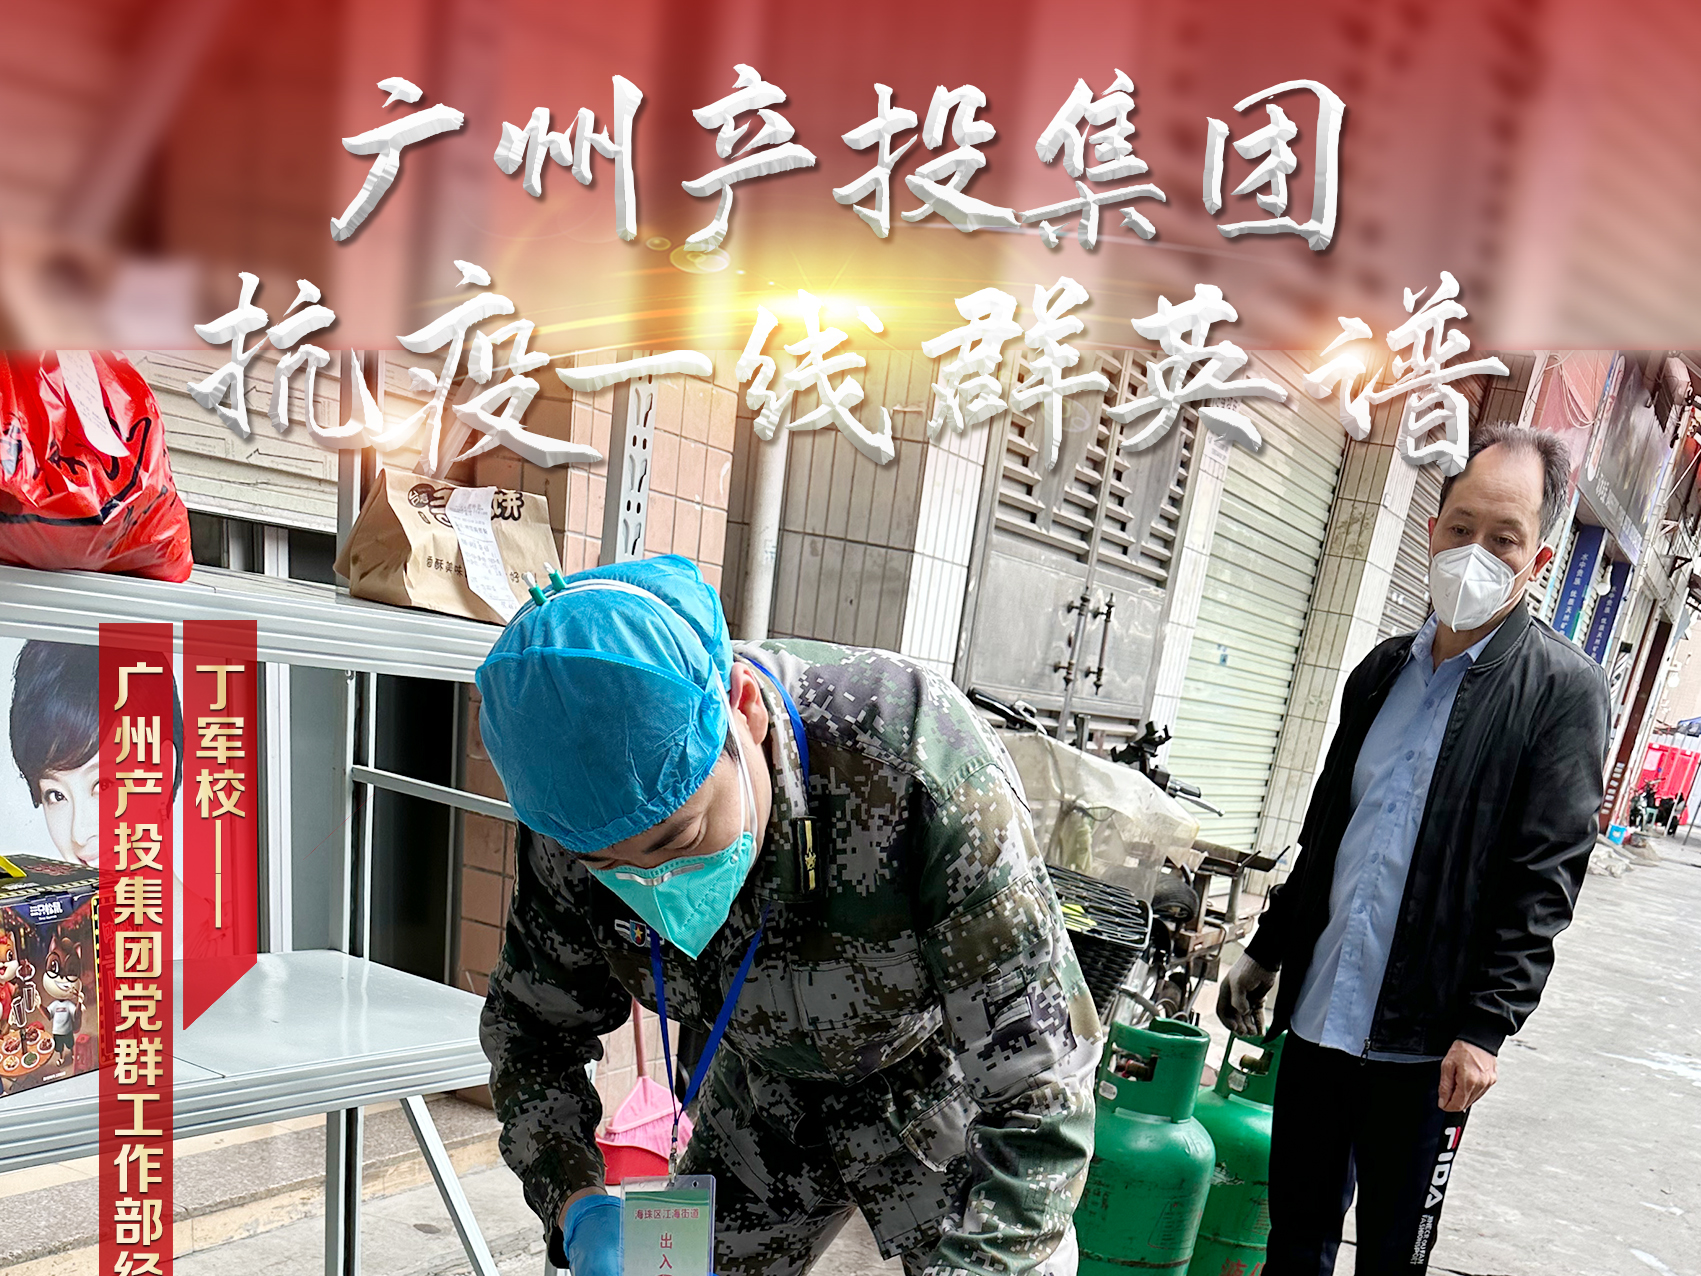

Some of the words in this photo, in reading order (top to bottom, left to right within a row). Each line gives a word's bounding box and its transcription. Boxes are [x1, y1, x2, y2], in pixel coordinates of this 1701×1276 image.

[1424, 1126, 1462, 1209] FIDA
[635, 1208, 699, 1220] 海珠区江海街道
